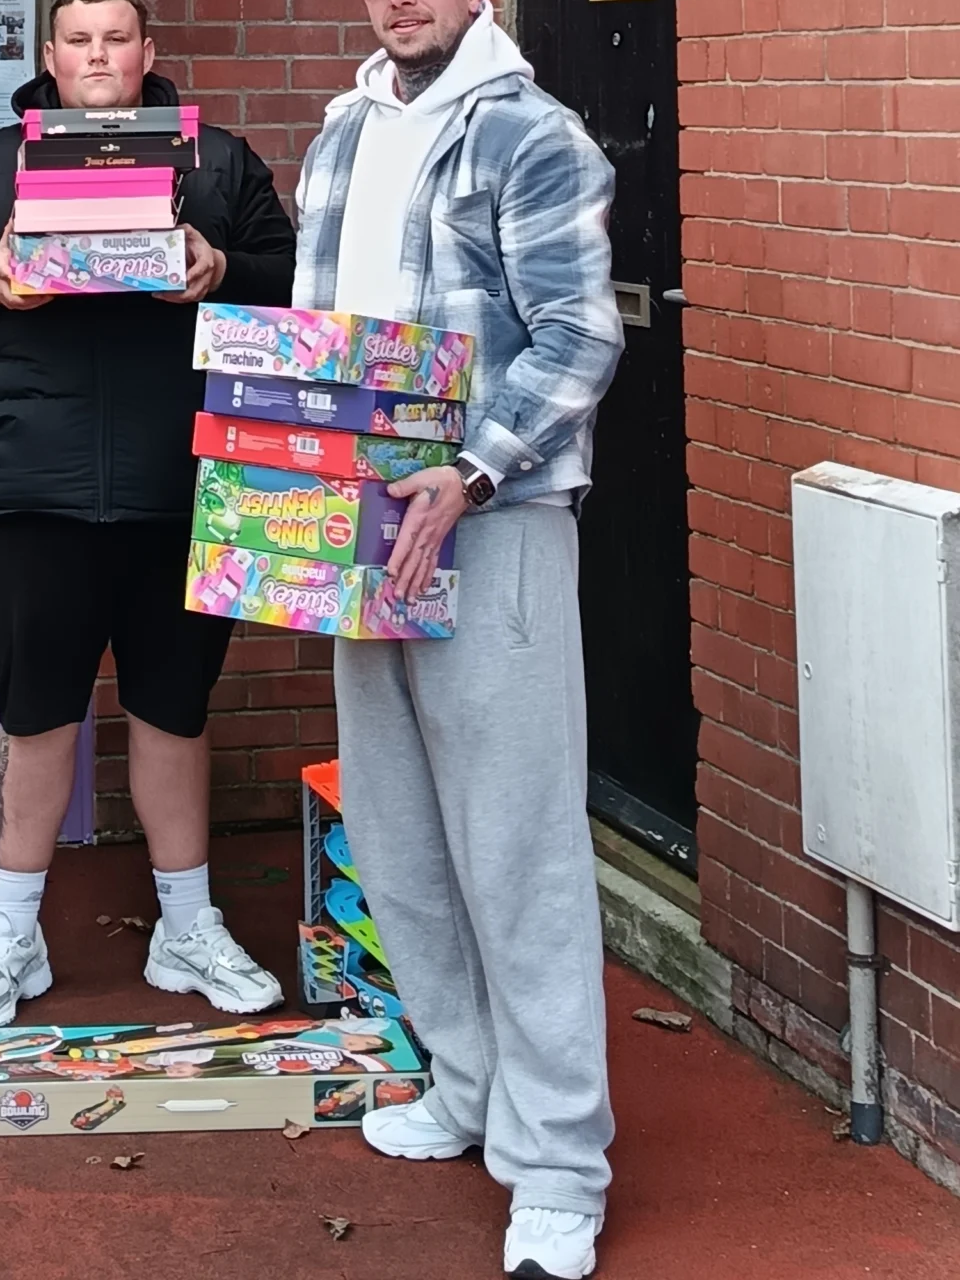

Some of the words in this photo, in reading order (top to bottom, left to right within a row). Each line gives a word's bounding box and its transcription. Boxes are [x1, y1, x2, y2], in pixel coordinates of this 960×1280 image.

[102, 237, 151, 252] machine
[87, 250, 168, 282] Sticker
[211, 319, 280, 353] Sticker
[222, 351, 264, 368] machine
[364, 333, 420, 372] Sticker
[236, 486, 327, 519] DENTIST
[264, 518, 321, 553] DINO
[281, 562, 327, 581] machine
[261, 578, 341, 618] Sticker
[243, 1051, 338, 1064] BOWLING
[0, 1105, 46, 1117] BOWLING
